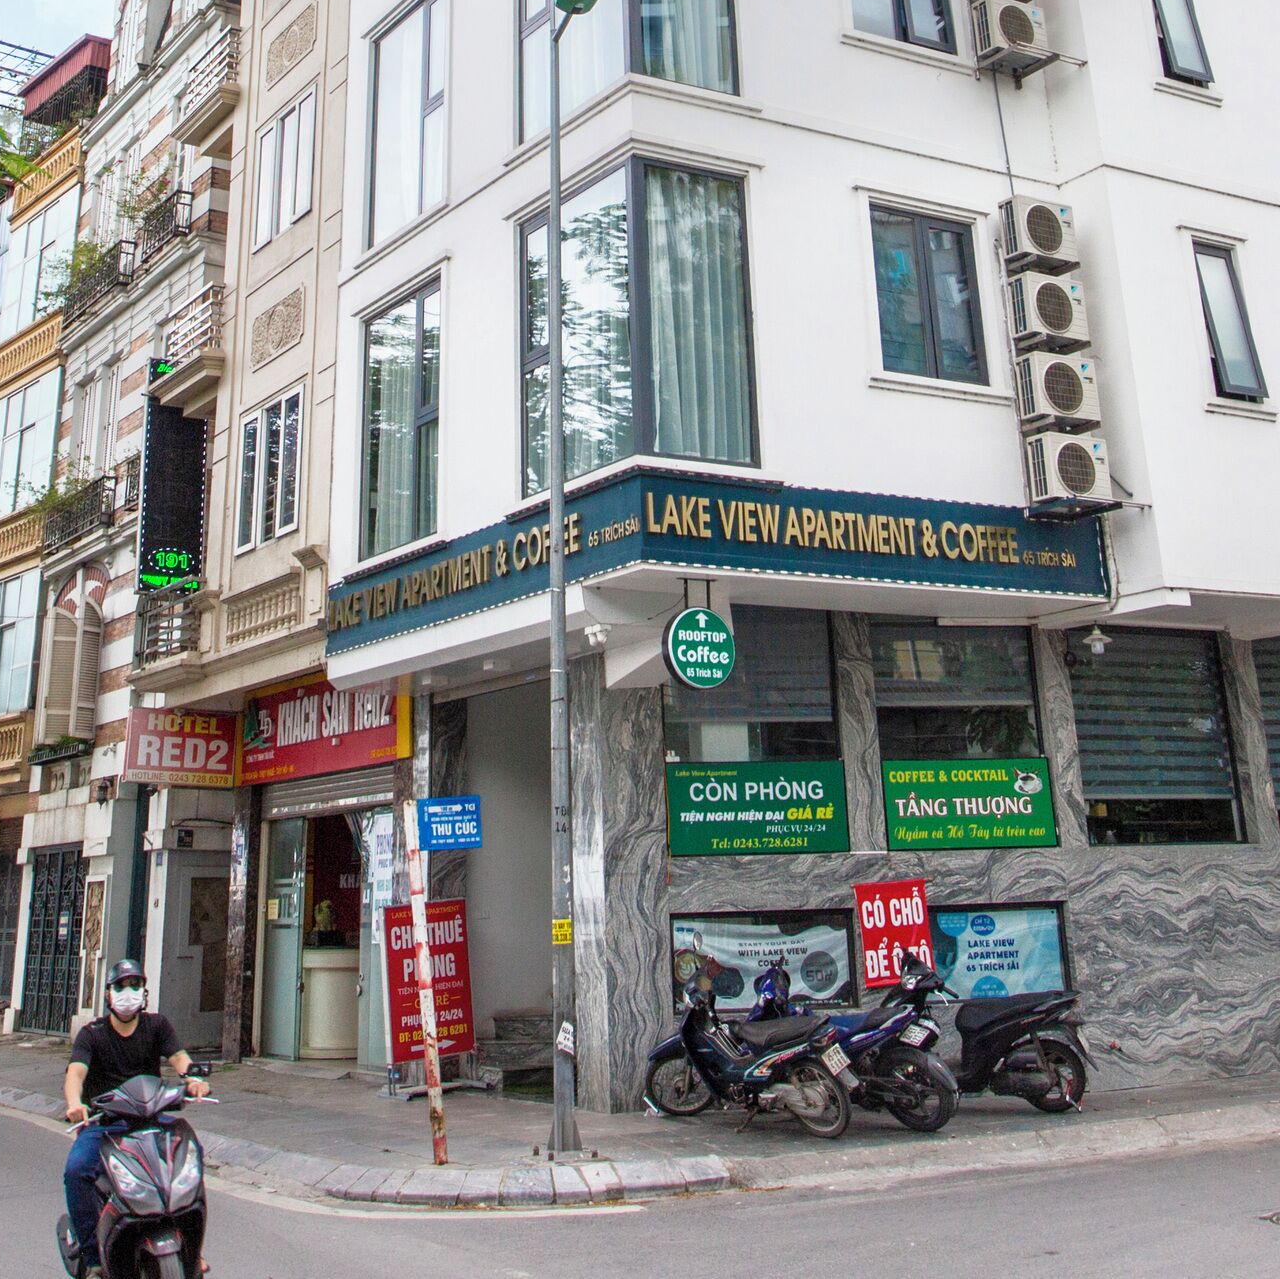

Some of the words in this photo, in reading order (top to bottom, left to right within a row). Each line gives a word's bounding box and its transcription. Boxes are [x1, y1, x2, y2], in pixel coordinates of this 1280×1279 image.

[645, 491, 712, 538] LAKE
[717, 498, 781, 545] VIEW
[783, 505, 916, 557] APARTMENT
[922, 521, 941, 558] &
[939, 521, 1020, 565] COFFEE
[1022, 550, 1035, 565] 65
[1037, 547, 1060, 568] TRÍCH
[1061, 548, 1077, 568] SÀI
[156, 552, 188, 569] 191
[362, 577, 400, 620] VIEW
[400, 545, 492, 608] APARTMENT
[495, 539, 508, 576] &
[513, 512, 581, 570] COFEE
[587, 533, 599, 548] 65
[600, 519, 625, 544] TRÍCH
[678, 629, 727, 643] ROOFTOP
[677, 644, 730, 664] Coffee
[686, 667, 695, 677] 65
[147, 712, 223, 735] HOTEL
[277, 688, 319, 747] KHÁCH
[321, 690, 351, 746] SẠN
[136, 734, 229, 770] RED2
[169, 773, 189, 782] 0243
[191, 774, 206, 783] 728
[888, 770, 934, 783] COFFEE
[938, 770, 948, 782] &
[951, 769, 1009, 782] COCKTAIL
[689, 777, 737, 802] CÒN
[745, 777, 824, 801] PHÒNG
[895, 791, 948, 817] TẦNG
[952, 795, 1033, 819] THƯỢNG
[680, 810, 705, 824] TIỆN
[706, 811, 735, 822] NGHI
[737, 809, 763, 823] HIỆN
[764, 811, 785, 823] ĐẠI
[787, 804, 813, 820] GIÁ
[816, 802, 834, 819] RẺ
[431, 823, 452, 836] THU
[455, 819, 477, 835] CÚC
[766, 825, 790, 834] PHỤC
[790, 825, 803, 834] VỤ
[803, 824, 826, 832] 24/24
[1006, 825, 1026, 837] trên
[1028, 827, 1046, 837] cao
[711, 838, 731, 849] Tel:
[733, 836, 808, 849] 0243.728.6281
[861, 894, 886, 929] CÓ
[889, 886, 924, 927] CHỖ
[391, 911, 407, 920] LAKE
[390, 924, 417, 950] CH
[968, 939, 991, 948] LAKE
[992, 938, 1015, 947] VIEW
[738, 949, 760, 957] WITH
[762, 948, 784, 956] LAKE
[786, 947, 808, 955] VIEW
[865, 937, 891, 979] ĐỂ
[967, 950, 1019, 960] APARTMENT
[966, 964, 976, 972] 65
[978, 961, 1005, 971] TRÍCH
[1006, 960, 1019, 970] SÀI
[435, 994, 450, 1007] RẺ
[440, 1008, 464, 1021] 24/24
[450, 1023, 468, 1035] 6281
